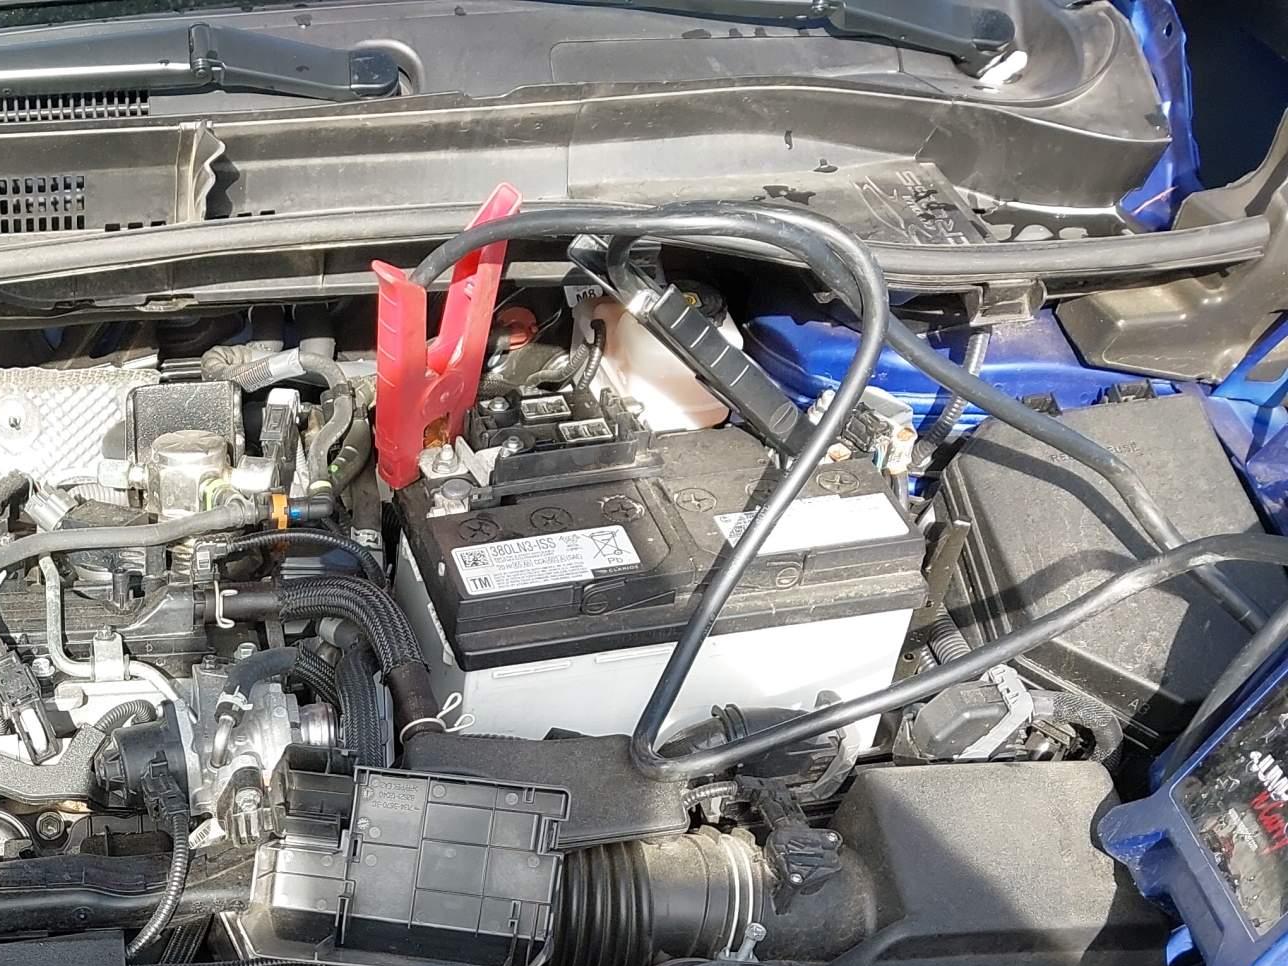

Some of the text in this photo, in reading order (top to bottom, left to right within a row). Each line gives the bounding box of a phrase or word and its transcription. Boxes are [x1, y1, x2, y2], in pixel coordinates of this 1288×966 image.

[489, 537, 557, 557] 380LN3-ISS
[607, 556, 624, 565] Pb
[470, 575, 492, 591] TM
